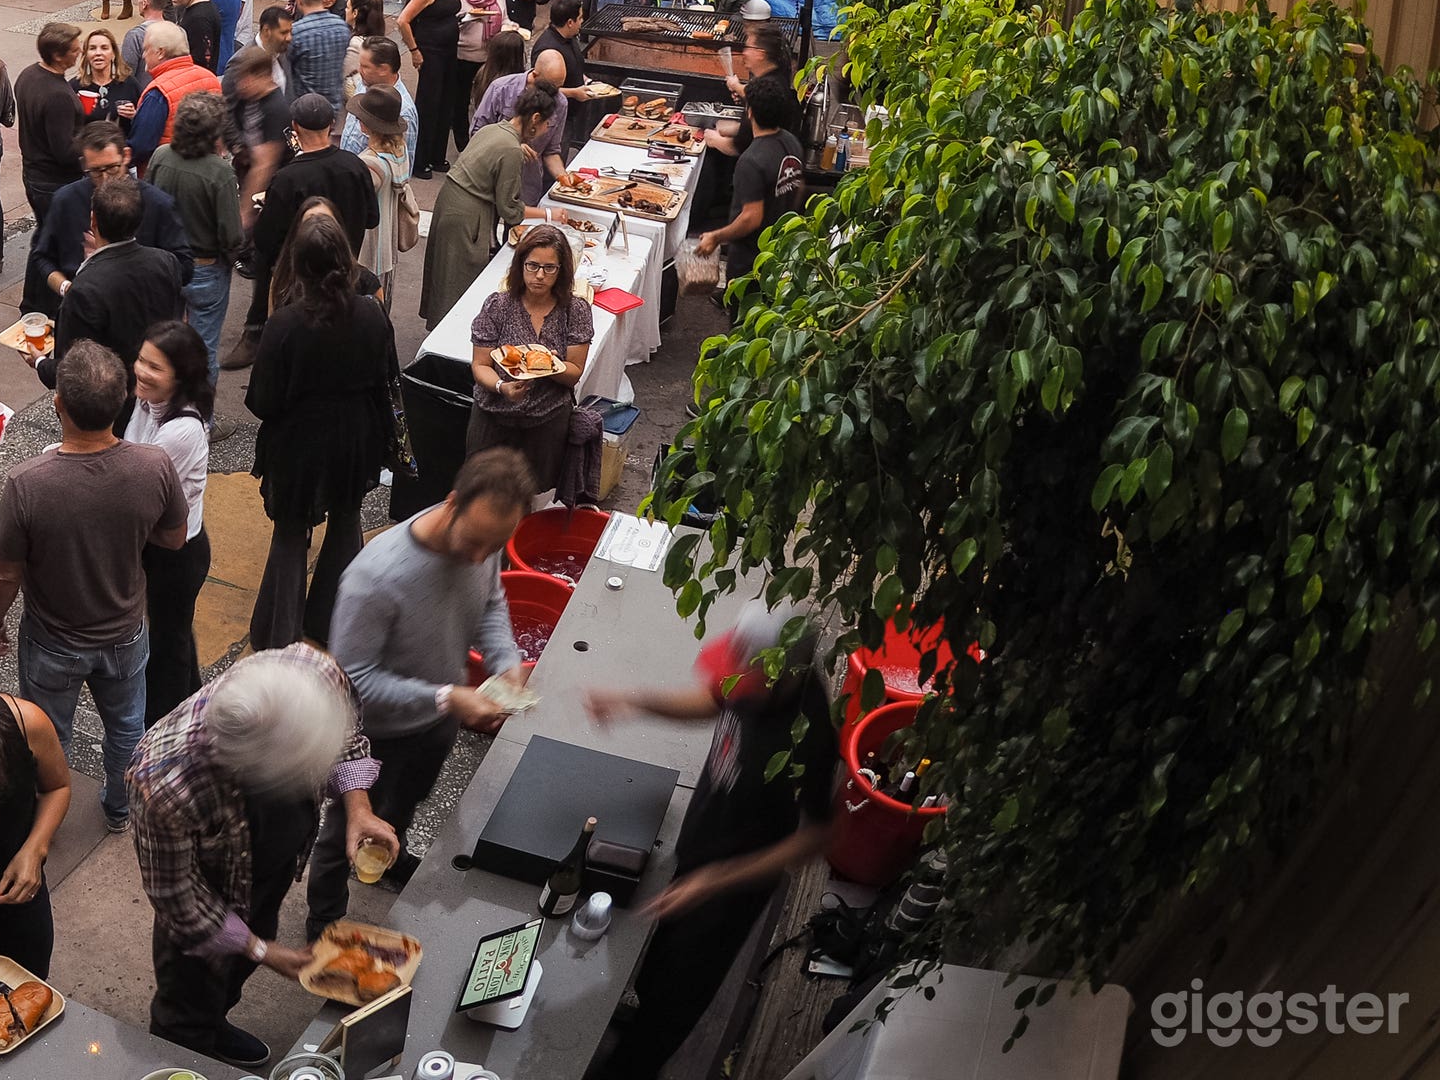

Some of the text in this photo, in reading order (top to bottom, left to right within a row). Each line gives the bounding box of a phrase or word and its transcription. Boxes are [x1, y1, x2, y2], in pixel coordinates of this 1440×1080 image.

[473, 949, 497, 992] PATIO
[487, 934, 515, 998] FUNK ZONE
